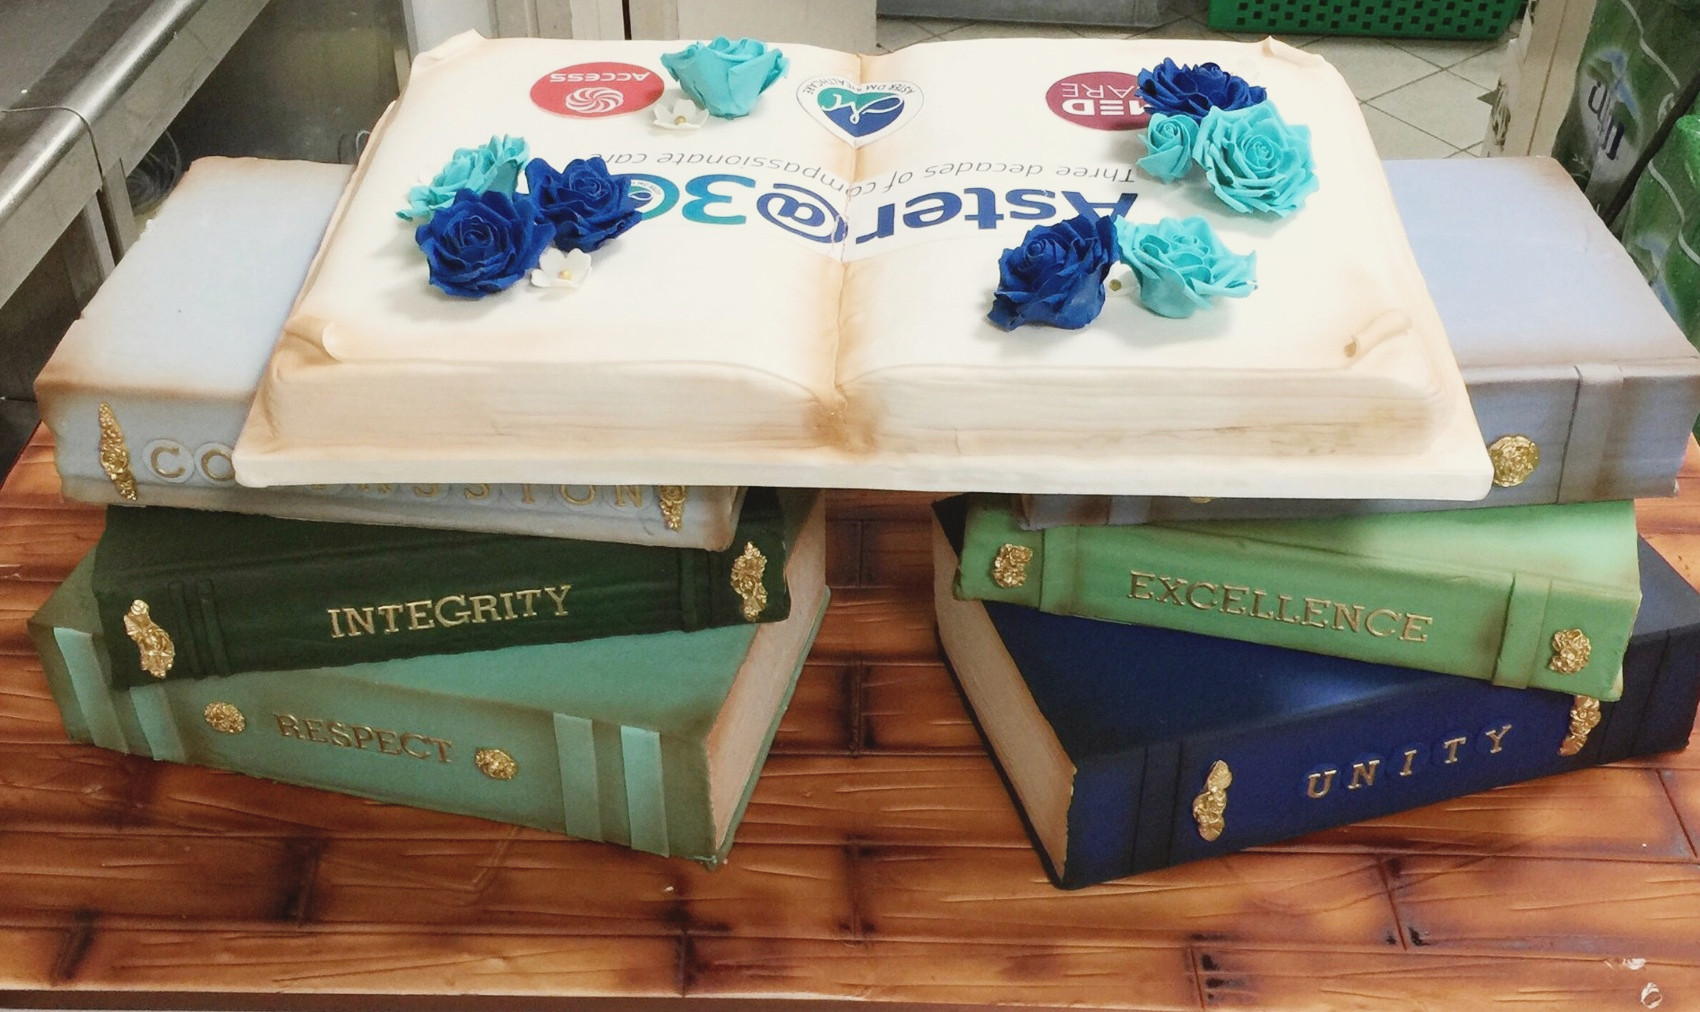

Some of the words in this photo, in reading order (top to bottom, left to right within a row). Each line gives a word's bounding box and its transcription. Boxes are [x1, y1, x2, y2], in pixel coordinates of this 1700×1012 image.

[549, 72, 651, 83] ACCESS
[888, 83, 915, 95] ASTER
[1061, 82, 1143, 98] ARE
[590, 153, 648, 164] car
[657, 152, 878, 198] compassionate
[883, 170, 914, 193] of
[923, 163, 1043, 180] decades
[1056, 167, 1136, 185] Three
[327, 583, 574, 639] INTEGRITY
[1126, 569, 1434, 644] EXCELLENCE
[273, 712, 453, 764] RESPECT
[1306, 722, 1513, 799] UNITY
